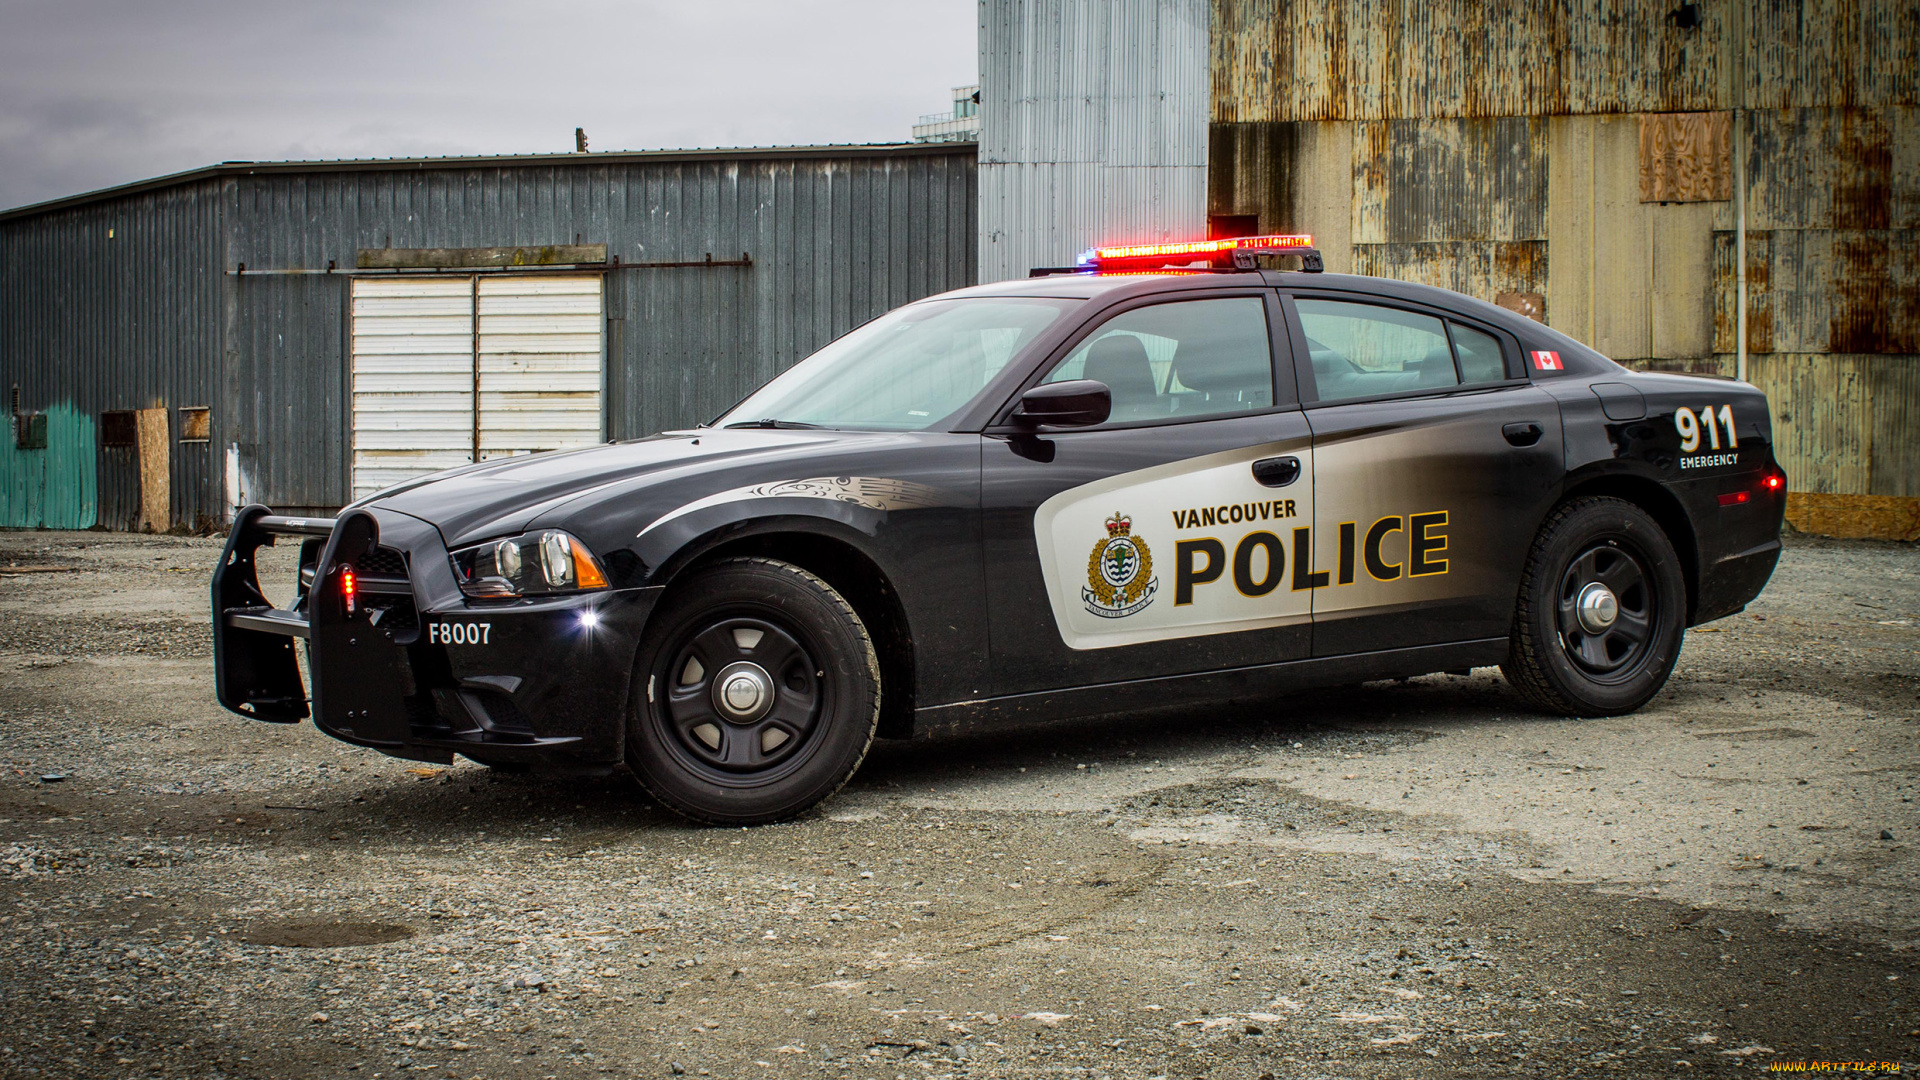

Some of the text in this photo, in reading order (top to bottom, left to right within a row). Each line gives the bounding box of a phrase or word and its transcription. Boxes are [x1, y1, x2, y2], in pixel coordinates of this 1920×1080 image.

[1674, 404, 1738, 453] 911
[1680, 453, 1738, 469] EMERGENCY
[1172, 499, 1297, 529] VANCOUVER
[1173, 510, 1449, 607] POLICE
[1088, 603, 1123, 617] VANCOUVER
[429, 623, 491, 644] F8007
